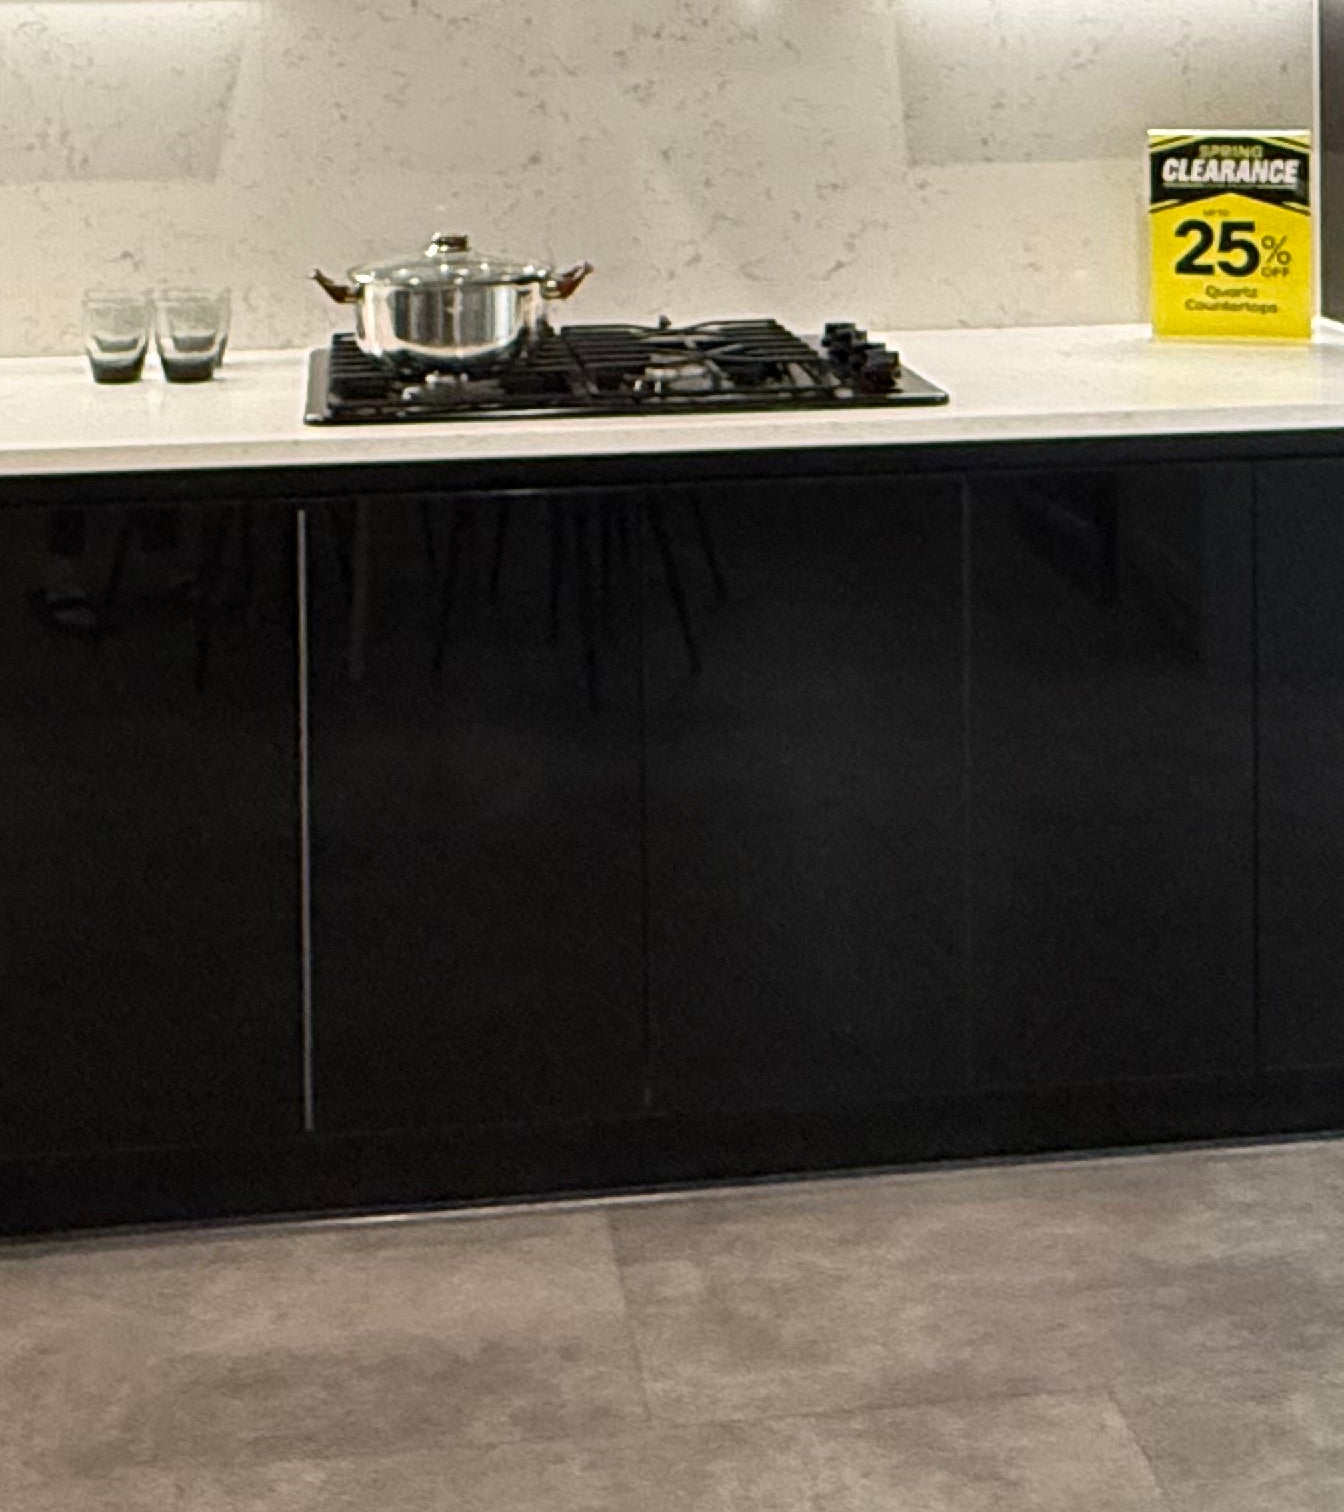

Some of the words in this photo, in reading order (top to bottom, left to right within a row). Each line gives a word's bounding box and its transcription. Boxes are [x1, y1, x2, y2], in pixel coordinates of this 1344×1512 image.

[1198, 144, 1264, 158] SPRING
[1161, 158, 1300, 185] CLEARANCE
[1260, 266, 1290, 278] OFF
[1205, 284, 1259, 300] Quartz
[1184, 299, 1279, 315] Countertops
